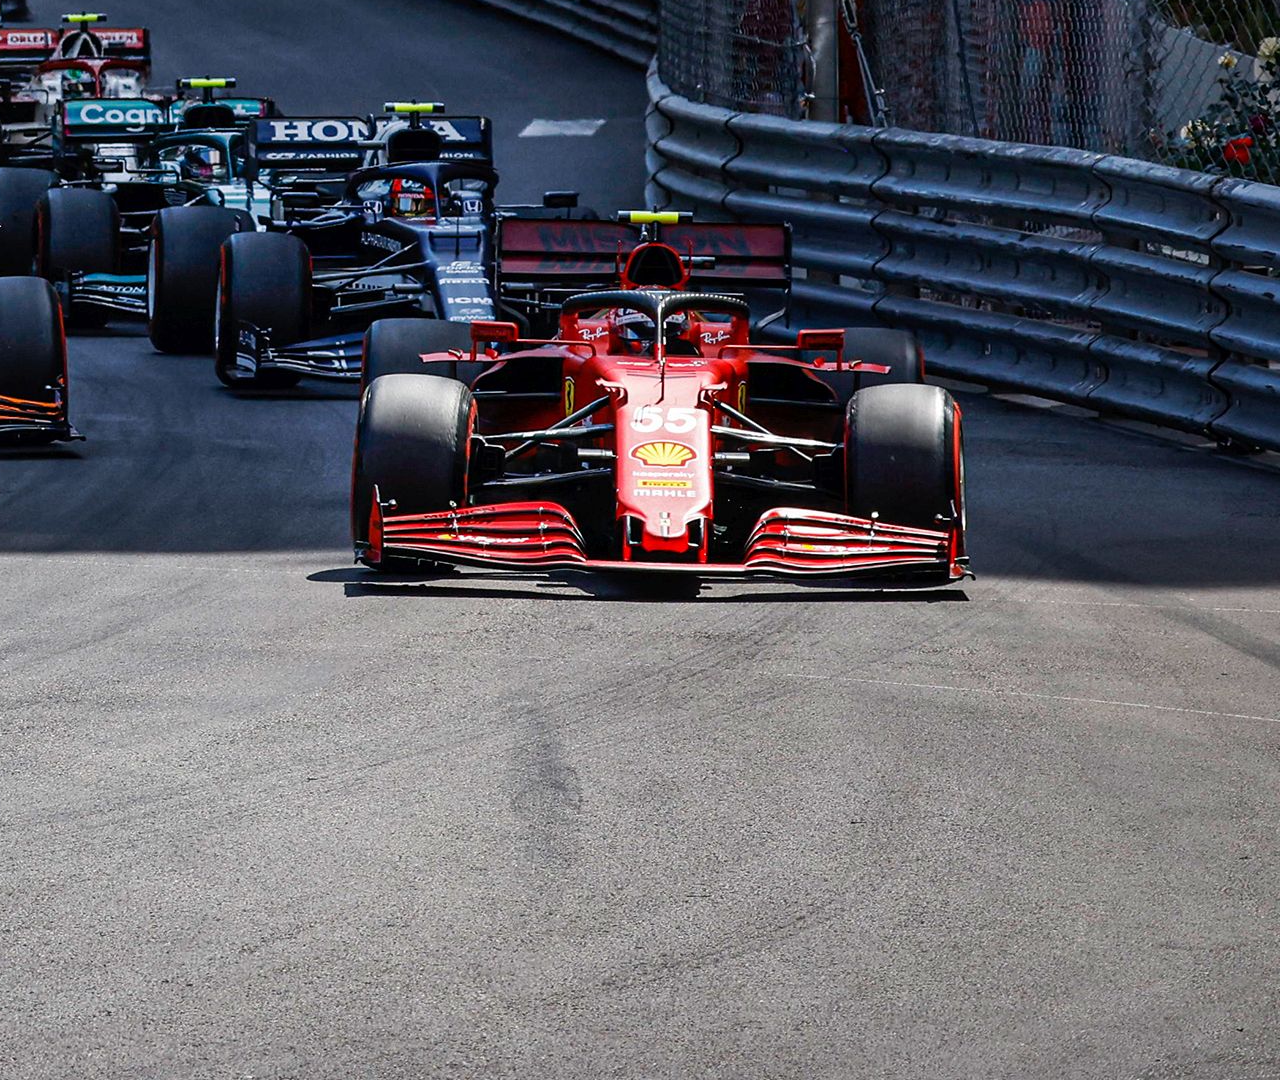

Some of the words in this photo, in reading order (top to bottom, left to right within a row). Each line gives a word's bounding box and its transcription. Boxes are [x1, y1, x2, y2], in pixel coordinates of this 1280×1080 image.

[270, 120, 467, 142] HONA
[538, 224, 753, 256] MISON
[97, 284, 146, 294] ASTON
[630, 407, 698, 434] 55
